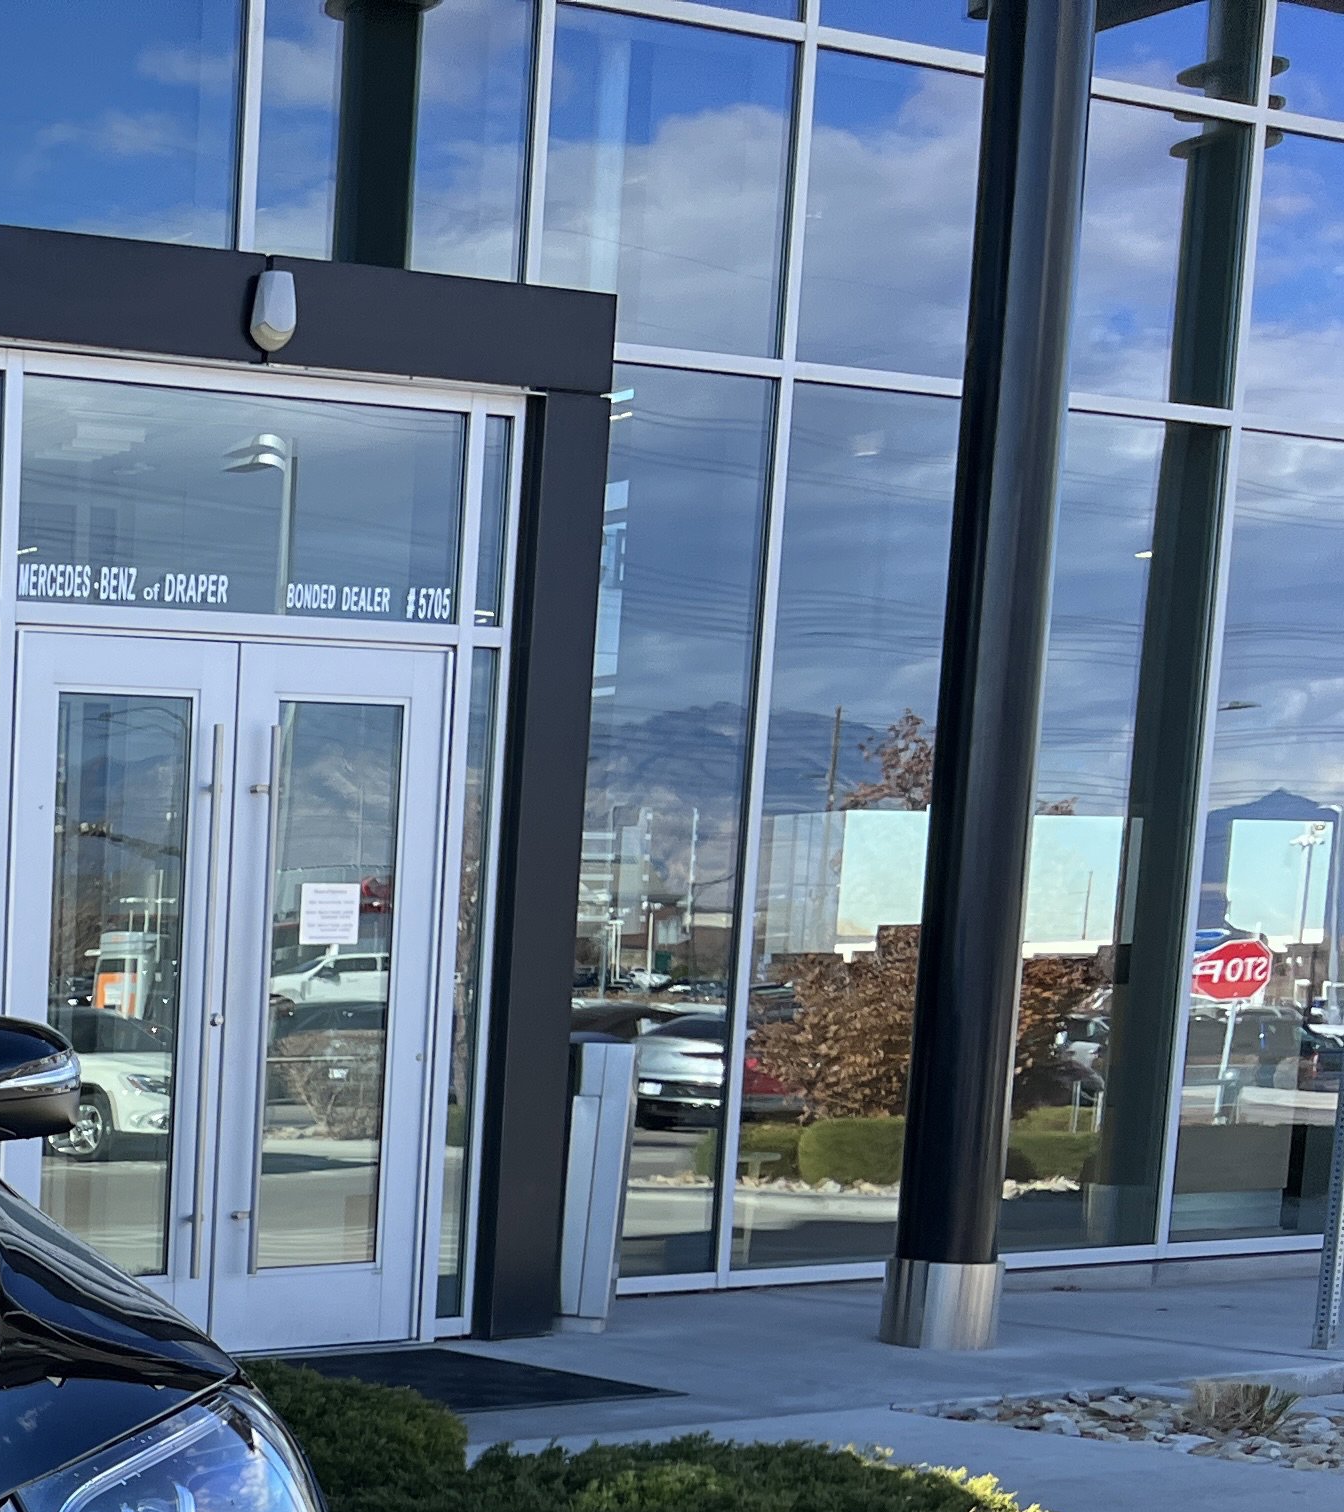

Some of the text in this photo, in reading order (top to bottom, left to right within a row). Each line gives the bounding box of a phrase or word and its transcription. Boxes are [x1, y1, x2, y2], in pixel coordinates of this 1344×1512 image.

[143, 583, 161, 601] of
[164, 573, 229, 604] DRAPER
[286, 583, 337, 610] BONDED
[341, 586, 391, 613] DEALER
